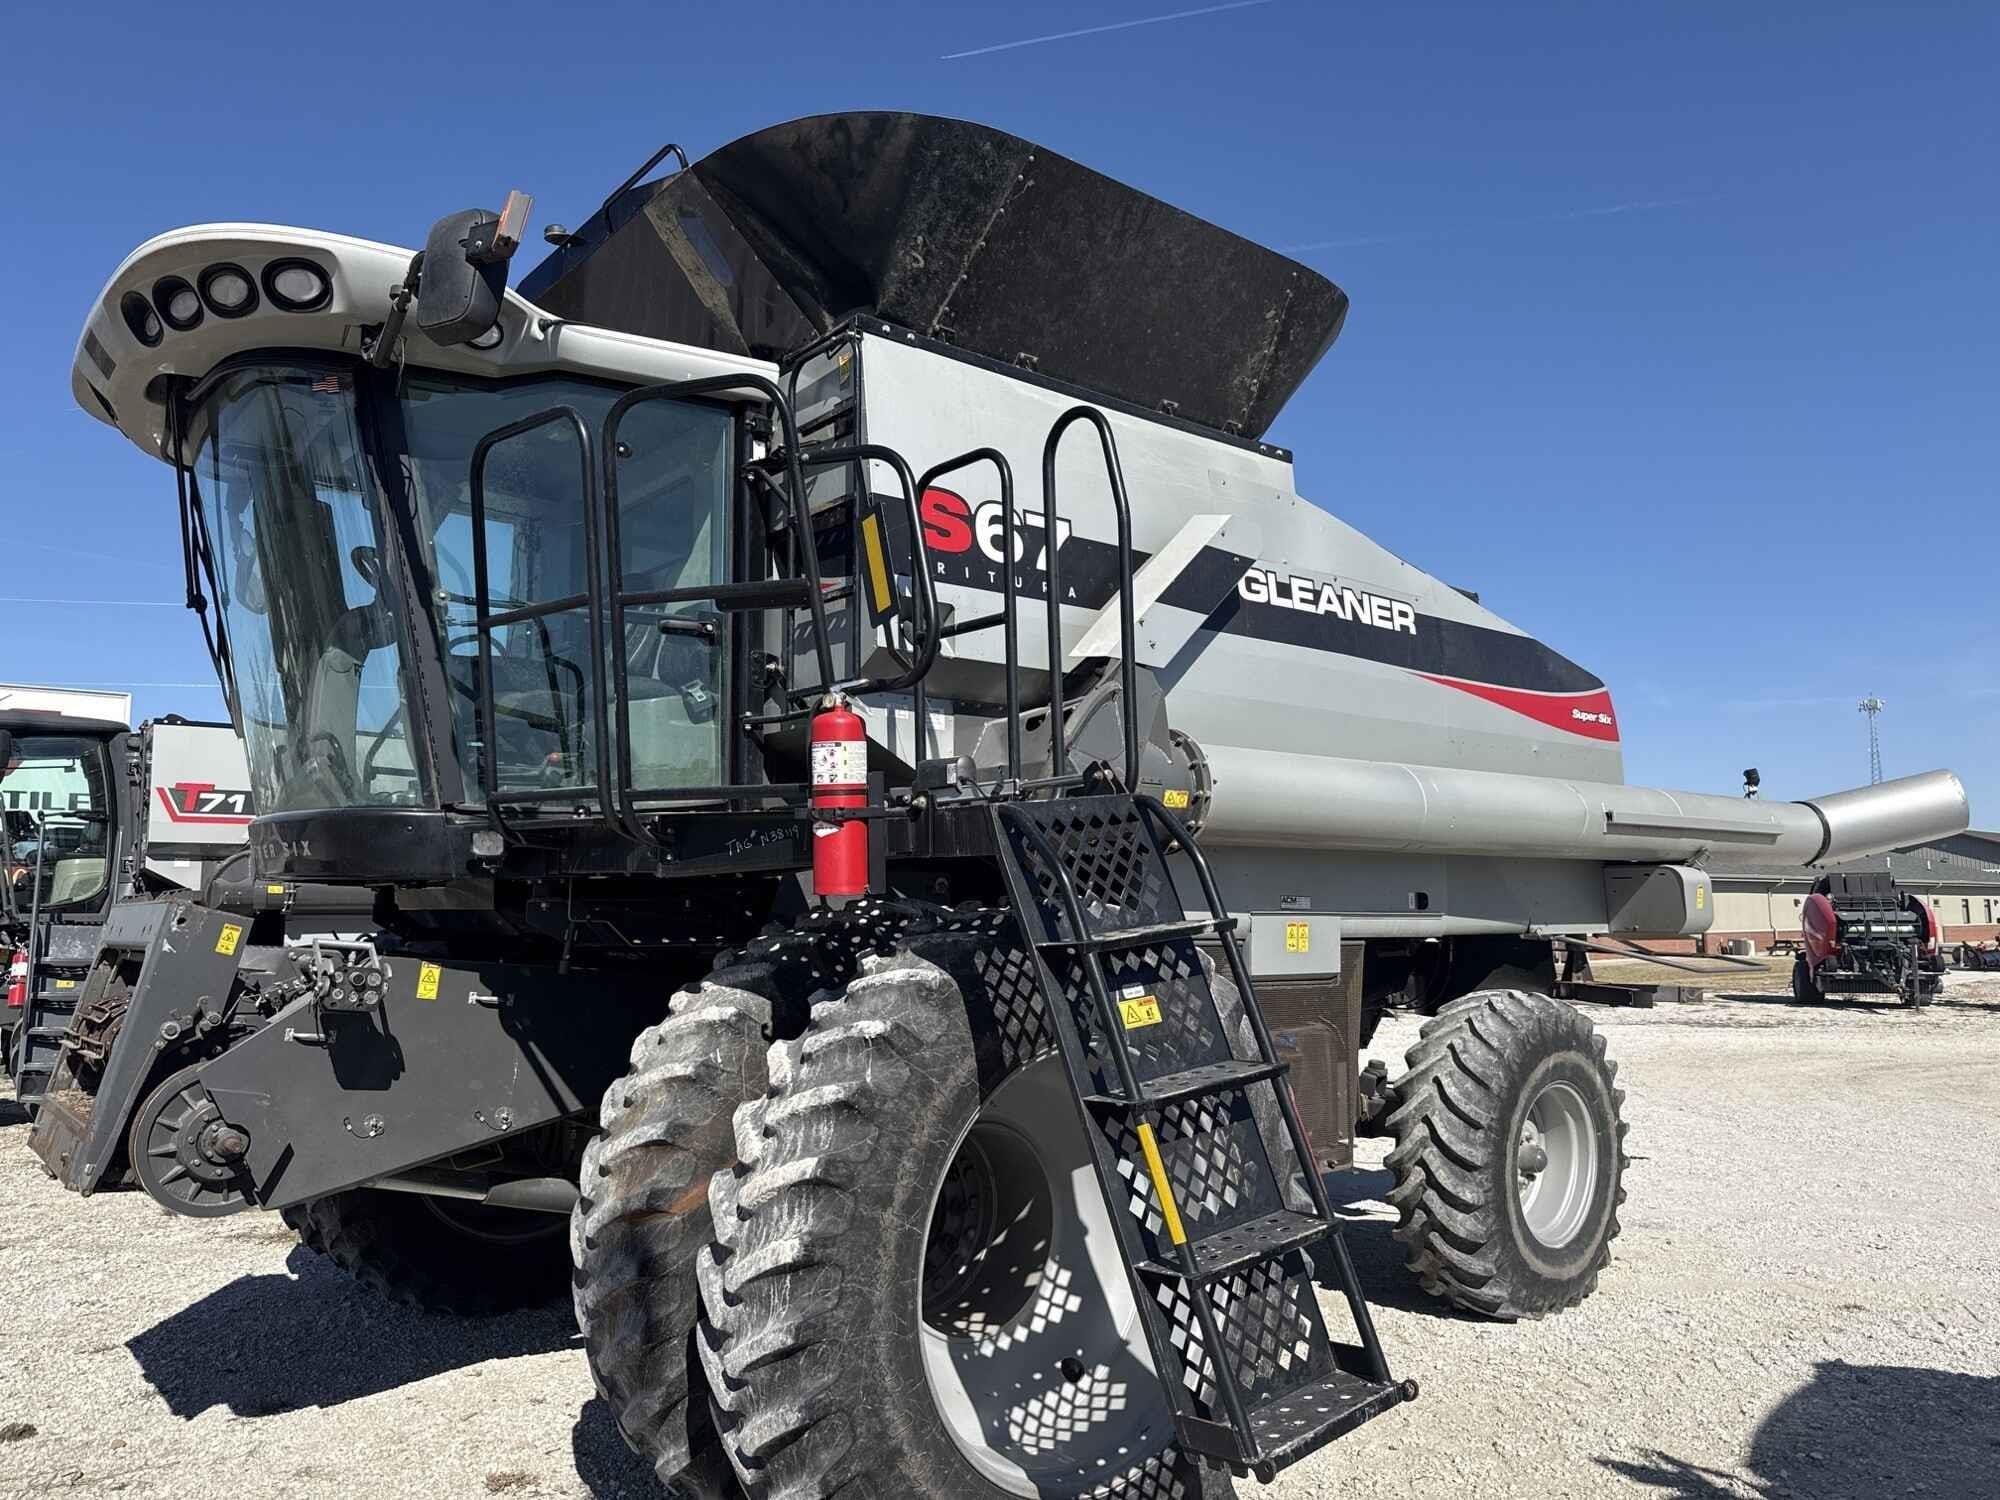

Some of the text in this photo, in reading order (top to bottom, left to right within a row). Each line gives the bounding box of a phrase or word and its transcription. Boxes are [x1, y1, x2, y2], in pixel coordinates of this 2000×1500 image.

[920, 486, 1072, 571] S67
[1238, 567, 1417, 635] GLEANER
[1571, 708, 1612, 725] Super Six
[175, 782, 246, 813] T71
